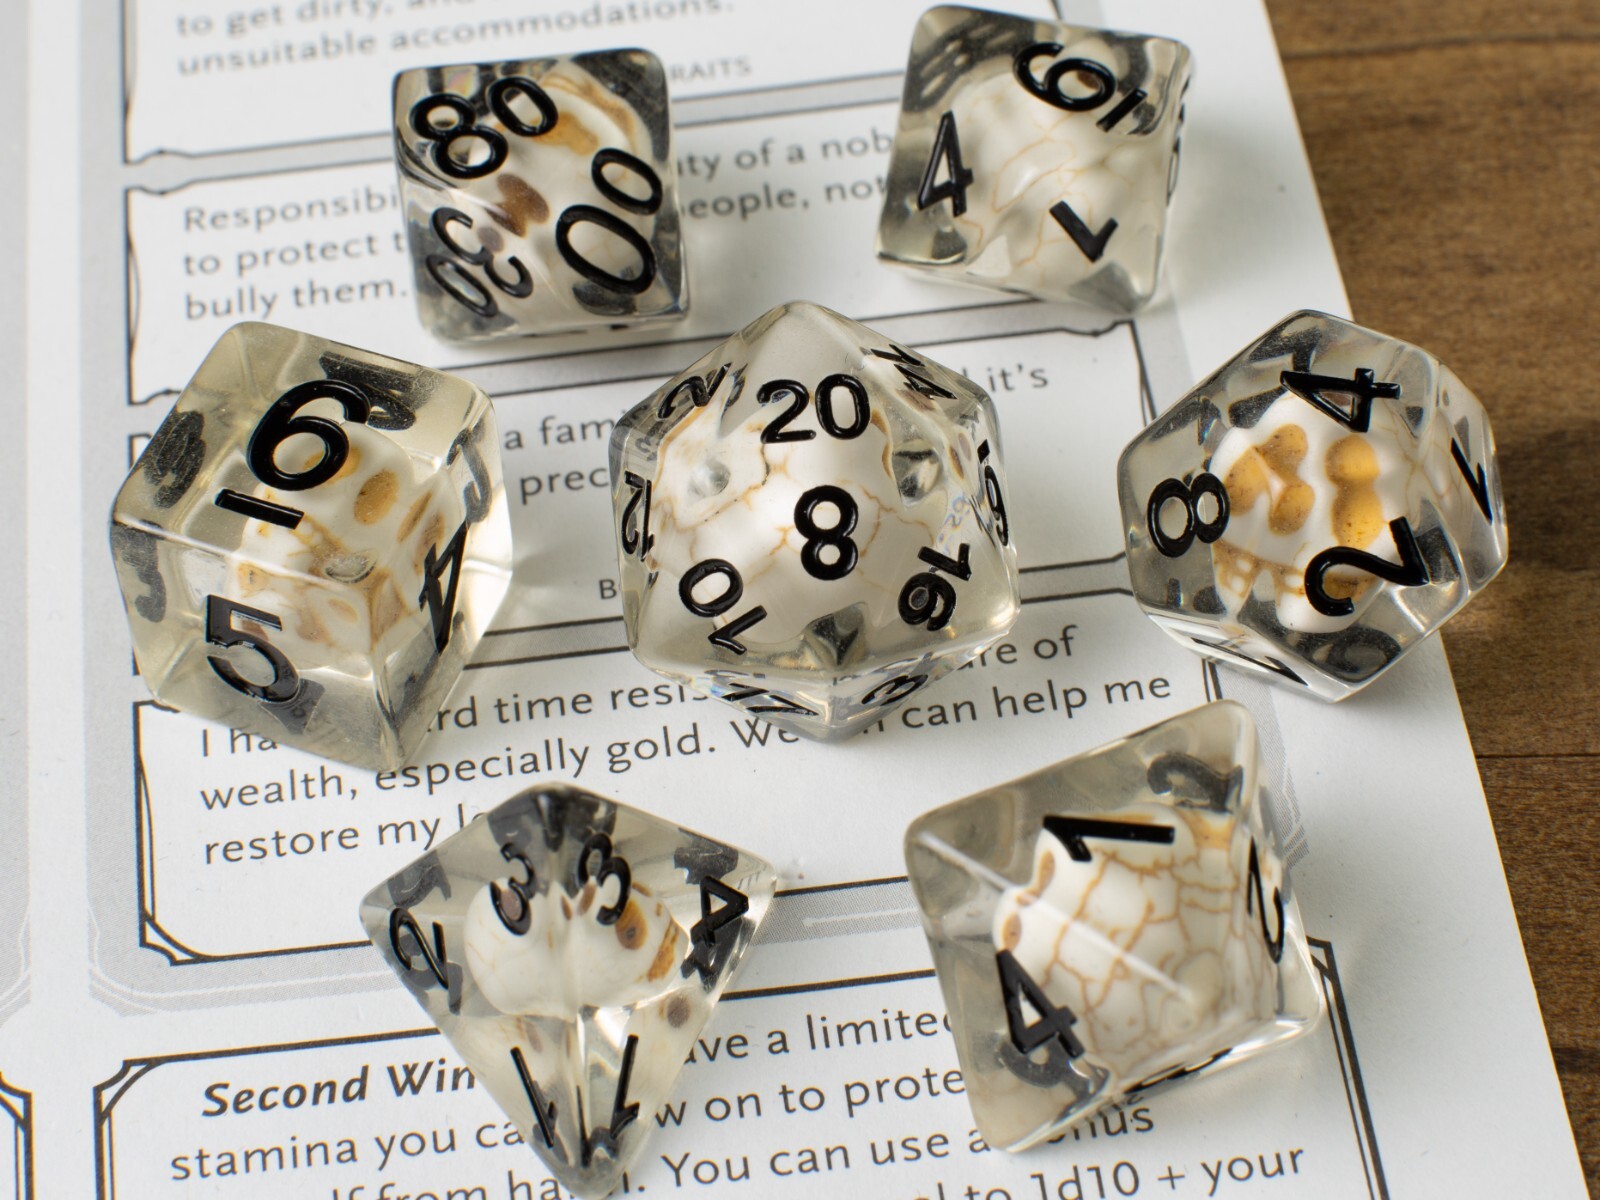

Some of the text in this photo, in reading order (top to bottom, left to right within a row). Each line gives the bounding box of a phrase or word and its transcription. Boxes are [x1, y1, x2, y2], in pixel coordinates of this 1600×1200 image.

[178, 32, 377, 76] unsuitable
[668, 55, 751, 81] RAITS
[408, 76, 558, 180] 80
[917, 111, 974, 218] 4
[184, 187, 399, 233] Responsibi
[735, 136, 774, 170] of
[787, 143, 806, 164] a
[820, 127, 894, 160] nob
[556, 147, 664, 296] 00
[184, 254, 221, 275] to
[236, 233, 378, 278] protect
[679, 182, 810, 222] eople,
[186, 277, 408, 320] bully them.
[505, 414, 618, 450] a fam
[756, 372, 871, 444] 20
[1280, 367, 1401, 433] 4
[519, 467, 611, 506] prec
[793, 484, 859, 581] 8
[1147, 473, 1231, 558] 8
[679, 558, 768, 655] 10
[1305, 516, 1431, 617] 2
[205, 594, 301, 704] 5
[427, 696, 478, 733] rd
[494, 691, 593, 725] time
[956, 641, 1018, 671] re
[1033, 624, 1079, 661] of
[200, 765, 358, 810] wealth,
[375, 737, 590, 796] especially
[607, 722, 716, 774] gold.
[901, 697, 978, 730] can
[992, 680, 1088, 719] help
[1105, 676, 1171, 705] me
[205, 818, 441, 865] restore my
[1043, 814, 1175, 863] 1
[995, 949, 1088, 1060] 4
[201, 1064, 370, 1118] Second
[386, 1058, 476, 1099] Win
[767, 1029, 790, 1055] a
[171, 1135, 358, 1182] stamina
[374, 1127, 457, 1172] you
[475, 1121, 526, 1149] ca
[704, 1091, 763, 1122] on
[779, 1083, 826, 1114] to
[844, 1067, 966, 1119] prote
[661, 1152, 751, 1188] You
[769, 1144, 851, 1177] can
[870, 1131, 950, 1166] use
[968, 1128, 992, 1153] a
[1200, 1147, 1304, 1198] your
